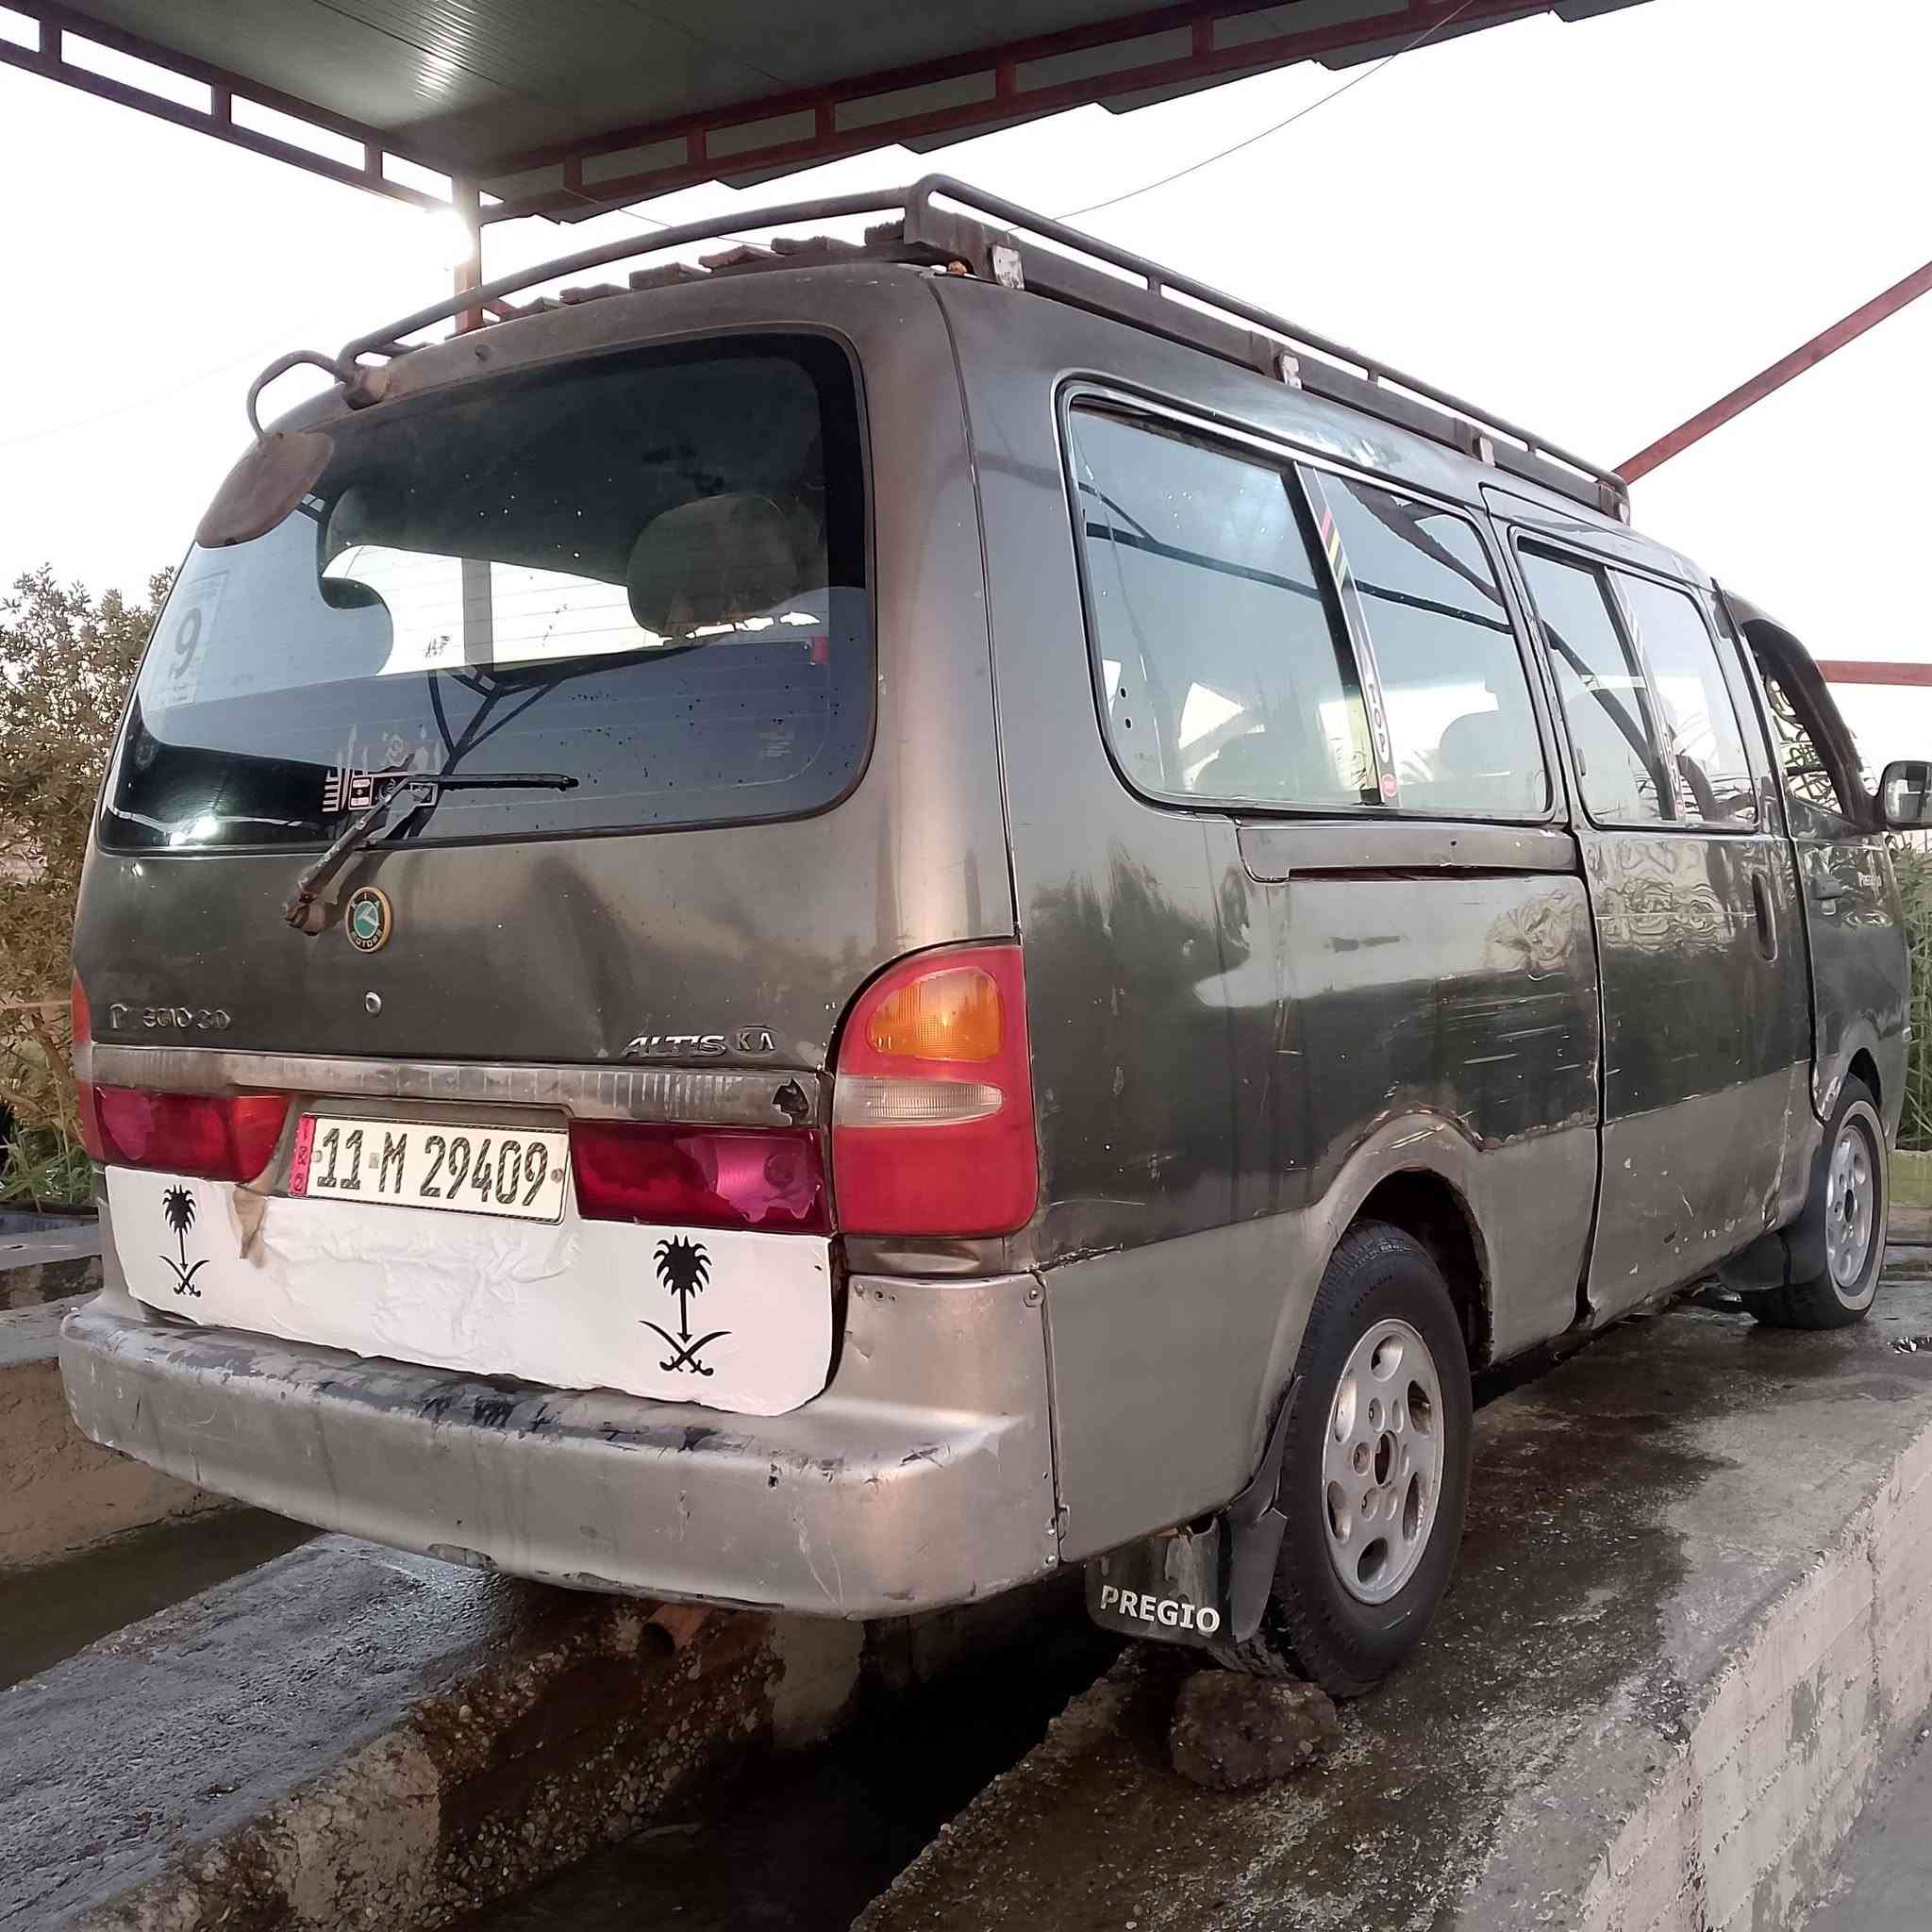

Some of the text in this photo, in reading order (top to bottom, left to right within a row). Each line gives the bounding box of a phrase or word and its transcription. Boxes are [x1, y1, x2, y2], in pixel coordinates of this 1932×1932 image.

[620, 1034, 726, 1058] ALTIS
[316, 1127, 549, 1207] 11 M 29409
[1100, 1584, 1221, 1633] PREGIO
